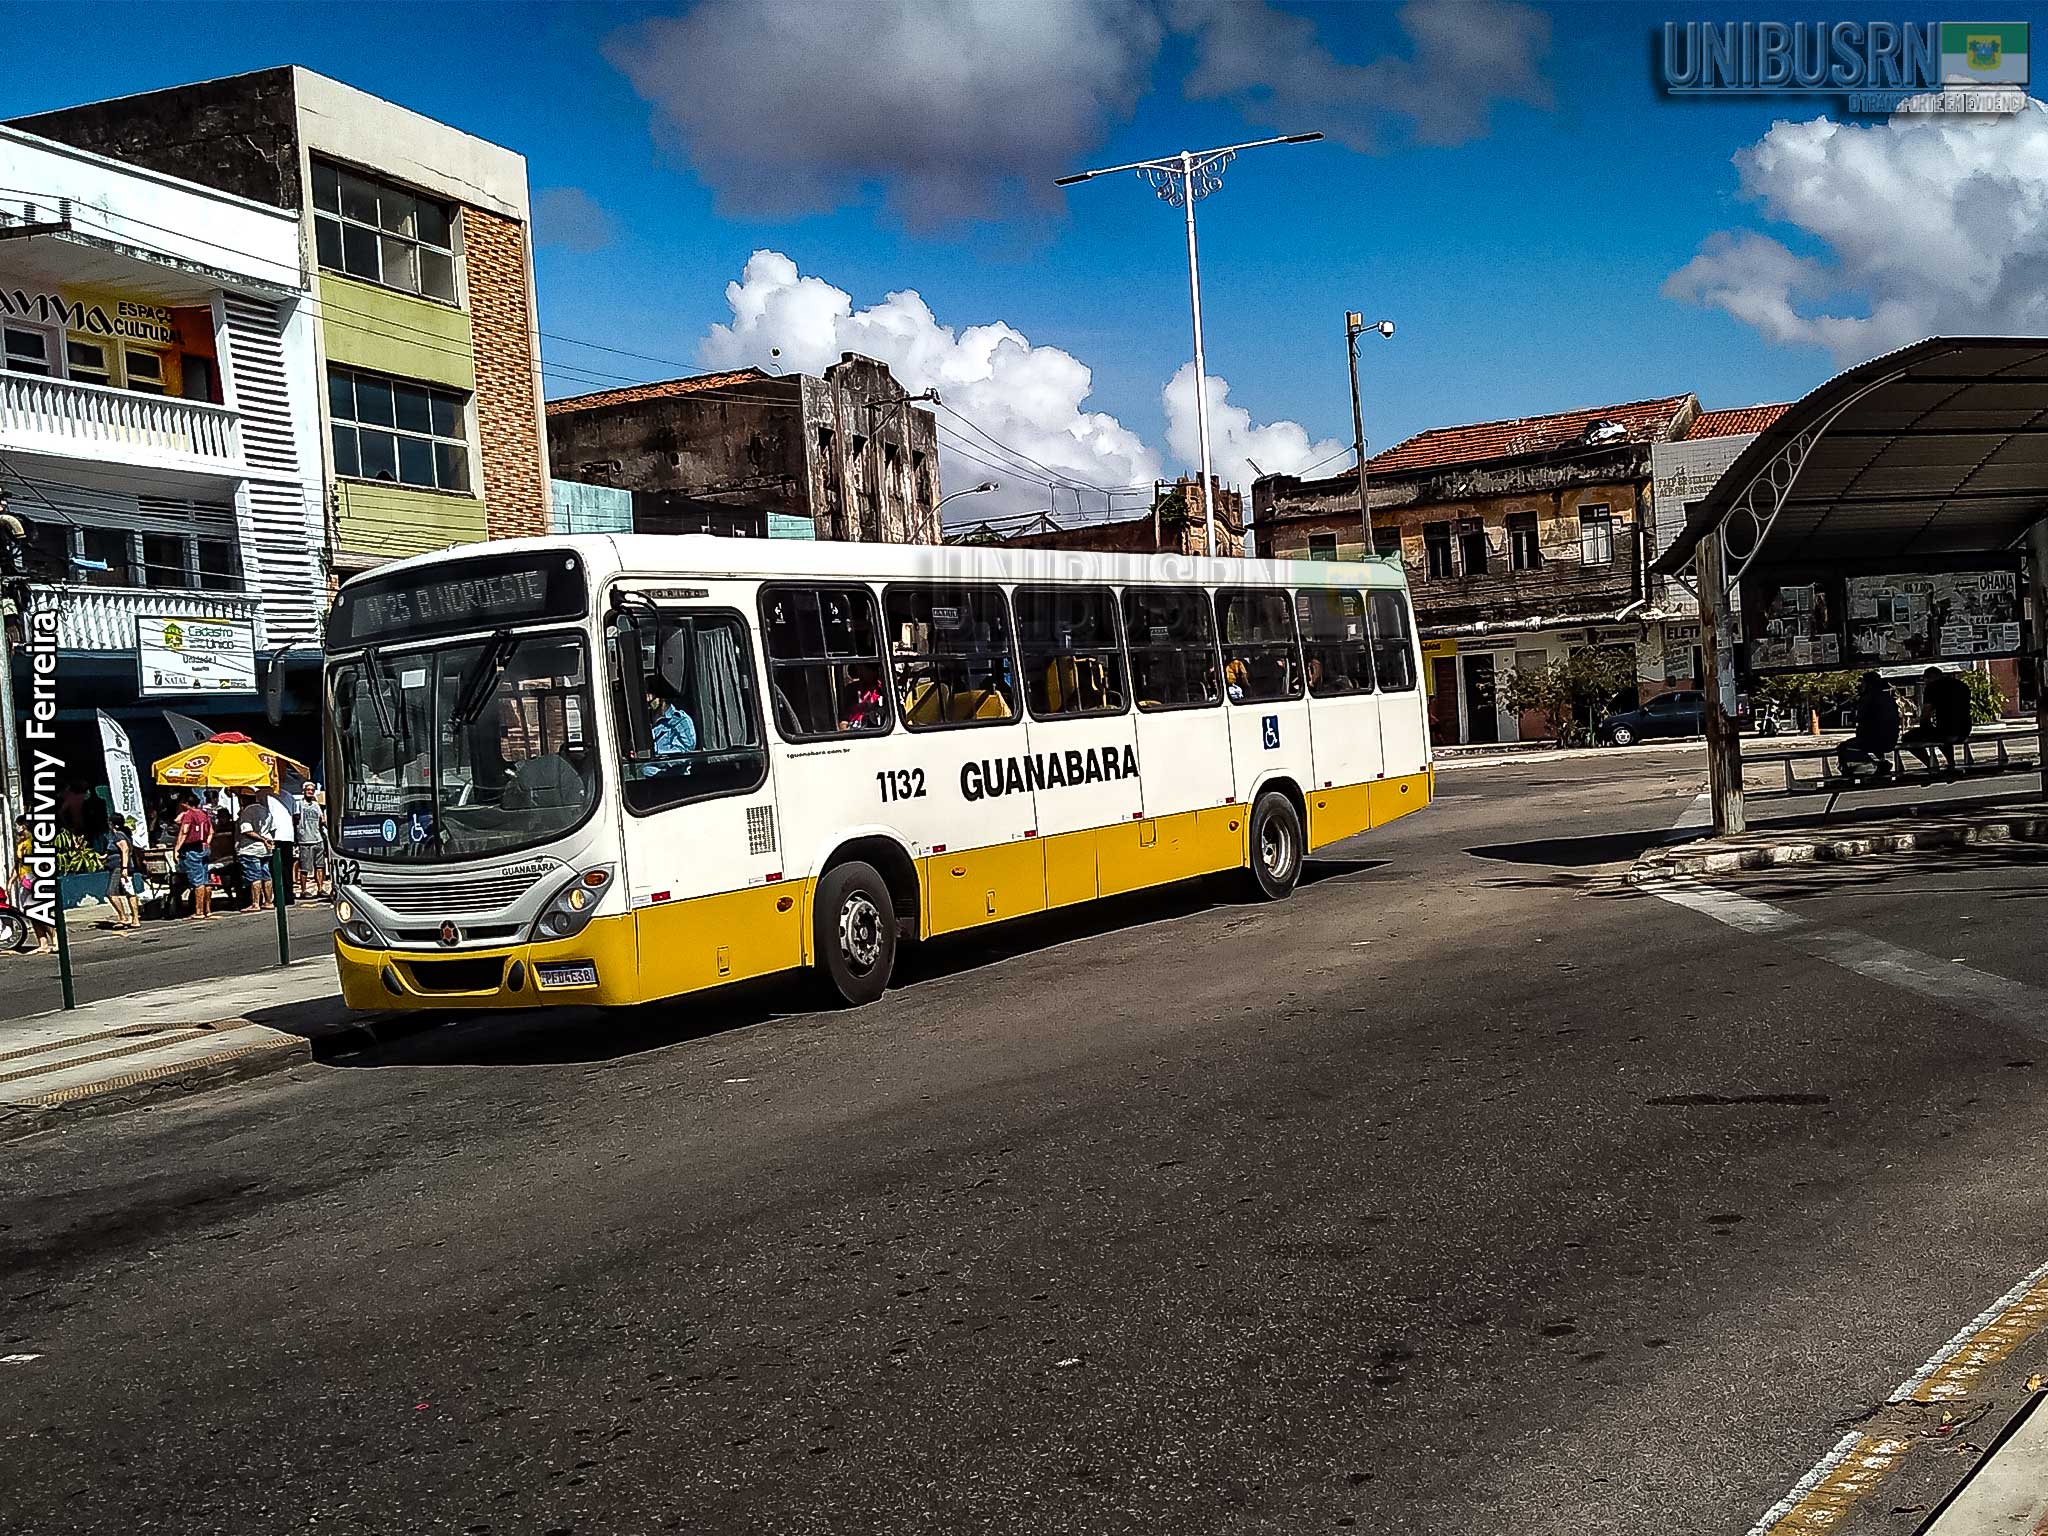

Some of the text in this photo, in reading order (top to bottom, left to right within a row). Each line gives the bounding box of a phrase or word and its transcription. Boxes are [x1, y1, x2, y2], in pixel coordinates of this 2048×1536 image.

[118, 301, 174, 325] ESPAÇO
[113, 318, 185, 345] CULTURAL
[188, 626, 233, 637] Cadastro
[876, 744, 1140, 803] 1132 GUANABARA
[501, 862, 556, 876] GUANABARA
